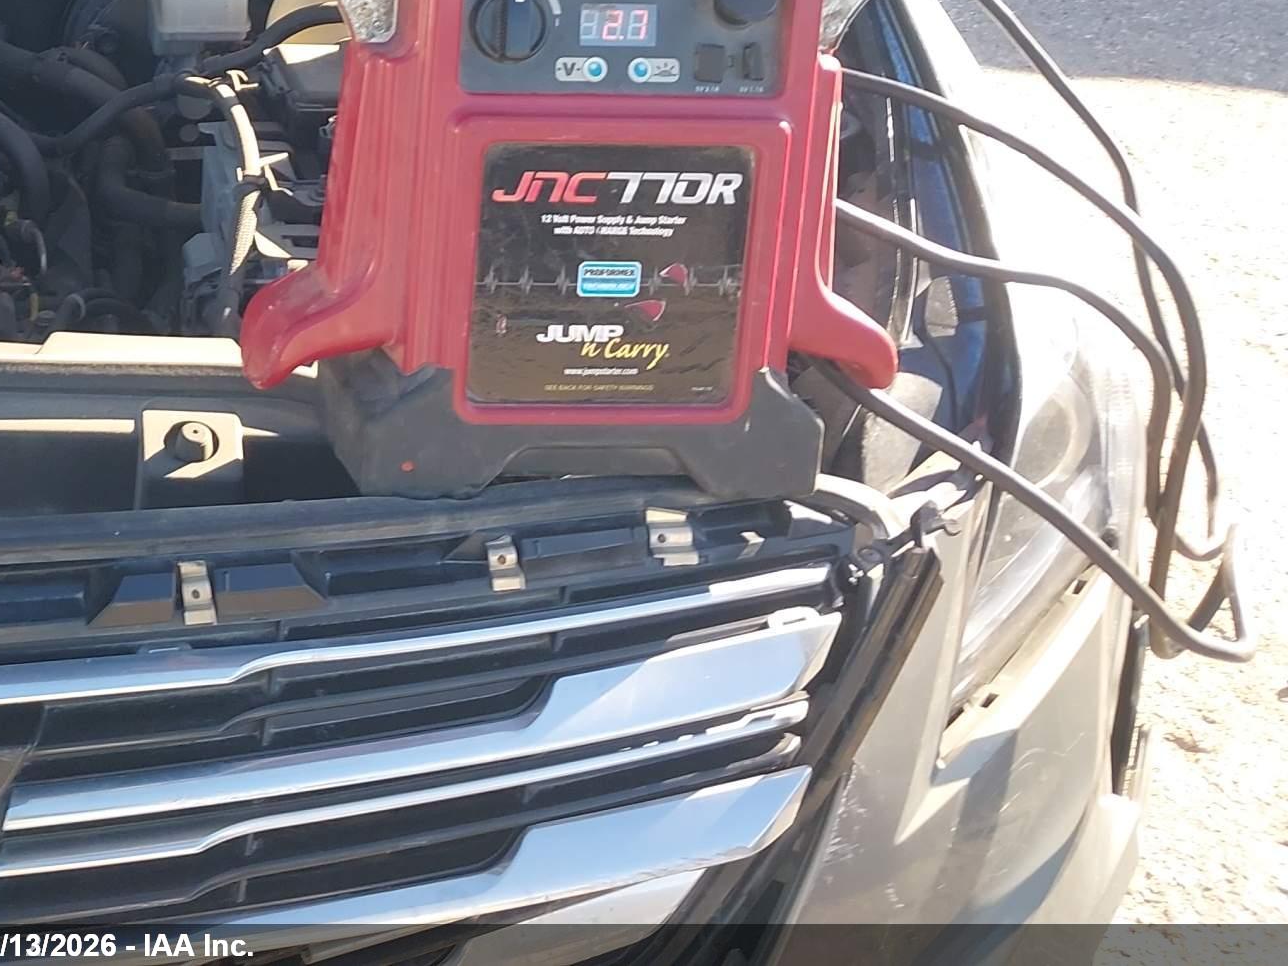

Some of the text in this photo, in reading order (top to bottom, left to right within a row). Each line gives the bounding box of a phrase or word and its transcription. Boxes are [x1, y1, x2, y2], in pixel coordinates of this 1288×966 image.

[491, 170, 743, 205] JNC770R
[541, 214, 553, 223] 12
[536, 324, 625, 343] JUMP
[580, 337, 669, 371] n Carry
